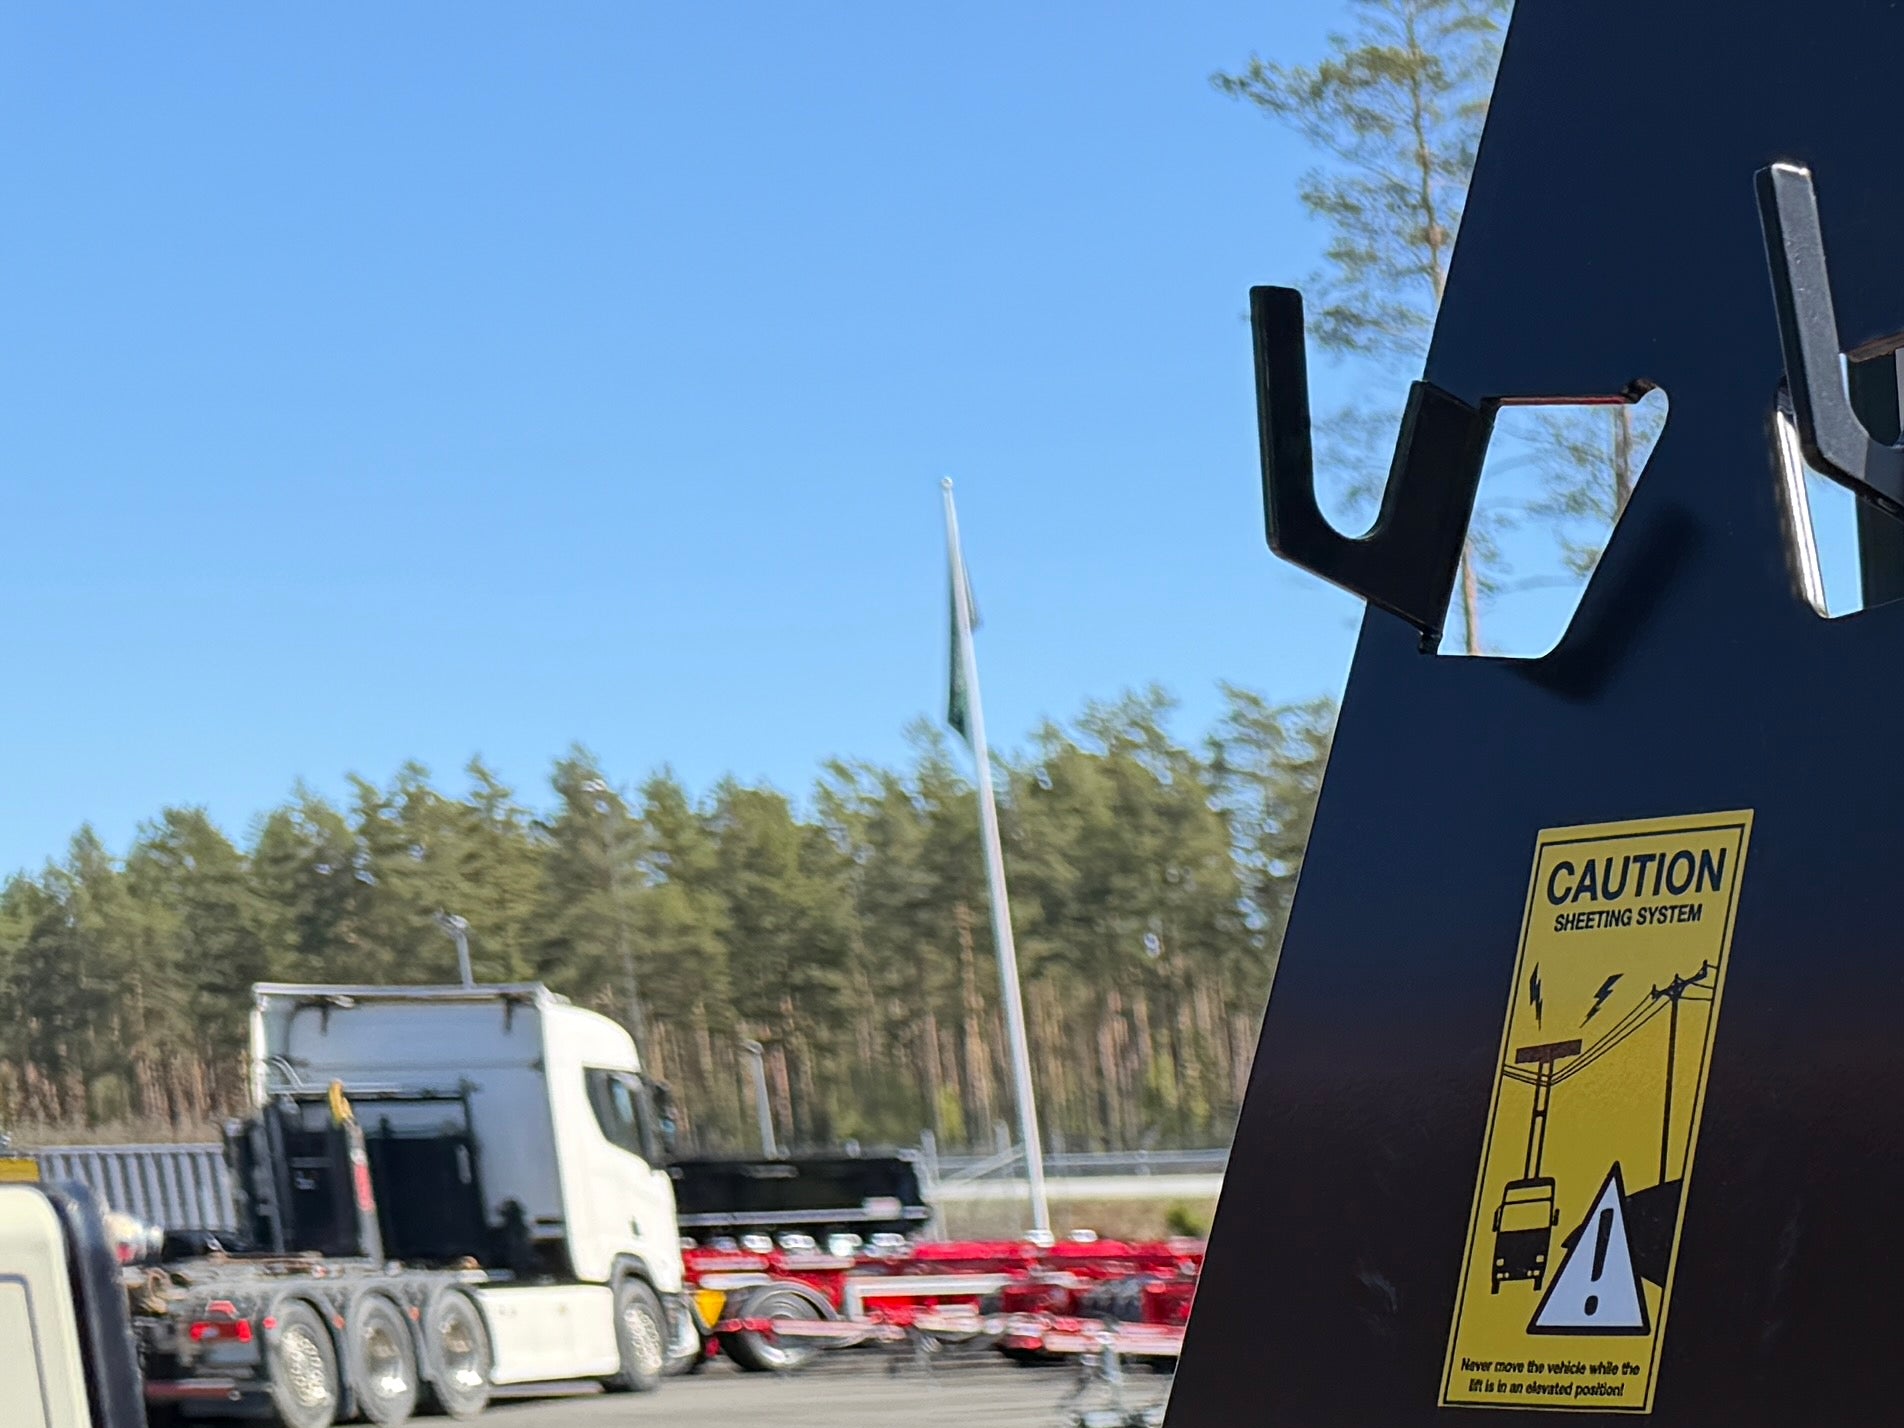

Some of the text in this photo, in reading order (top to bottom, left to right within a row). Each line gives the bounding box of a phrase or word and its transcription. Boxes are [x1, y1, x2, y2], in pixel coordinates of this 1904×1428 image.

[1546, 847, 1728, 906] CAUTION
[1553, 903, 1703, 933] SHEETING SYSTEM
[1460, 1357, 1641, 1377] Never move the vehicle while the
[1468, 1378, 1625, 1400] lift is in an elevated position!
